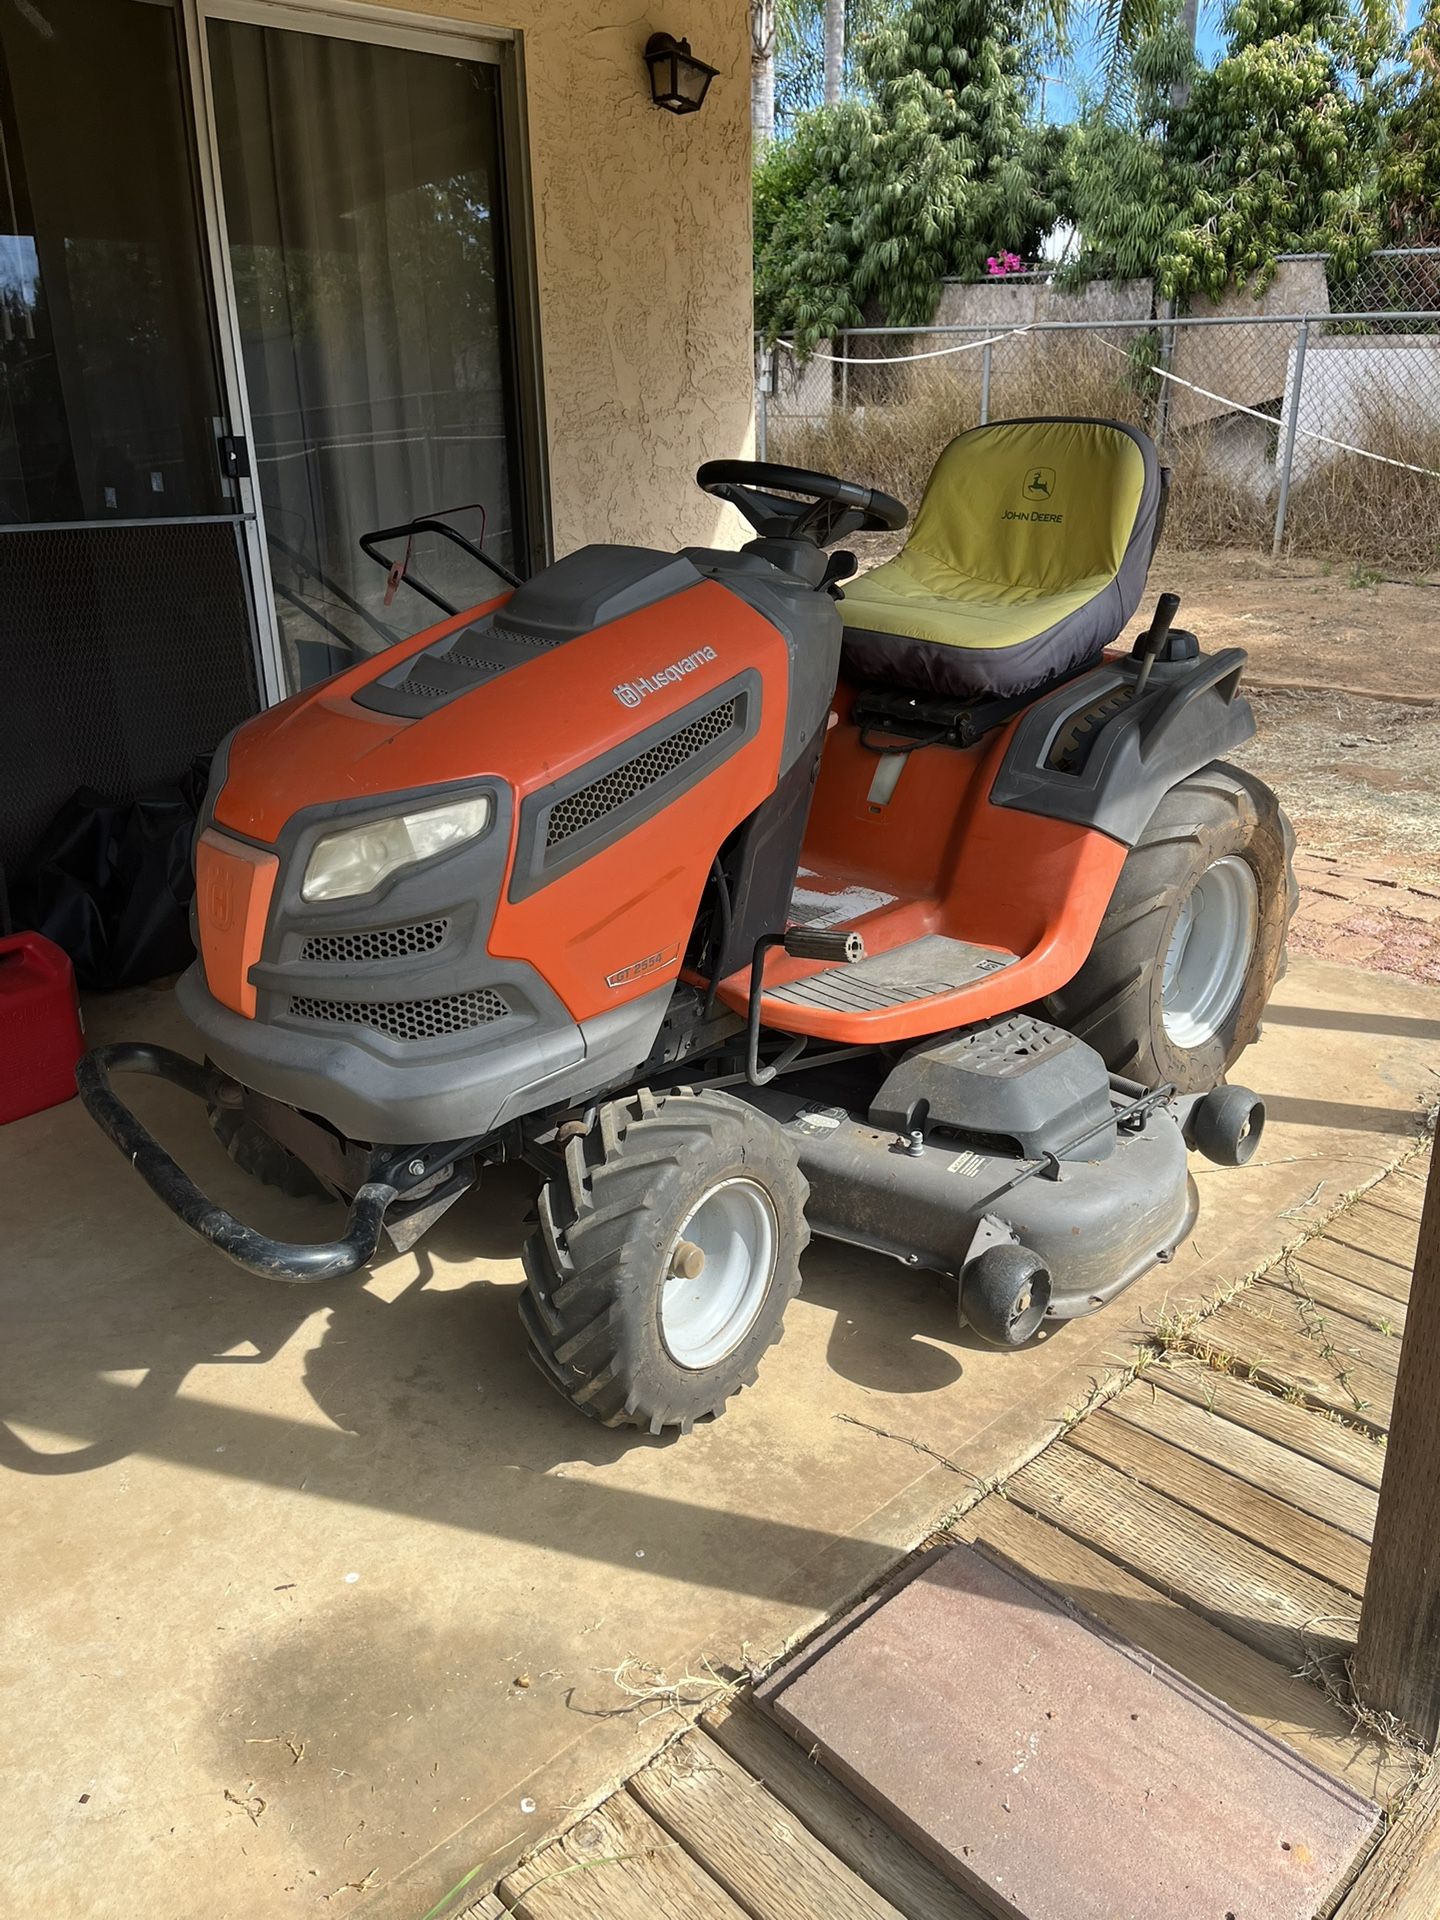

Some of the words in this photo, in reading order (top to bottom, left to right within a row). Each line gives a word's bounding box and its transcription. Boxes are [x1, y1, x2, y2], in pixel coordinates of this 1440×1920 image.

[1001, 509, 1029, 521] JOHN
[1031, 511, 1063, 524] DEERE
[632, 645, 718, 697] Husqvarna
[616, 968, 630, 982] GT
